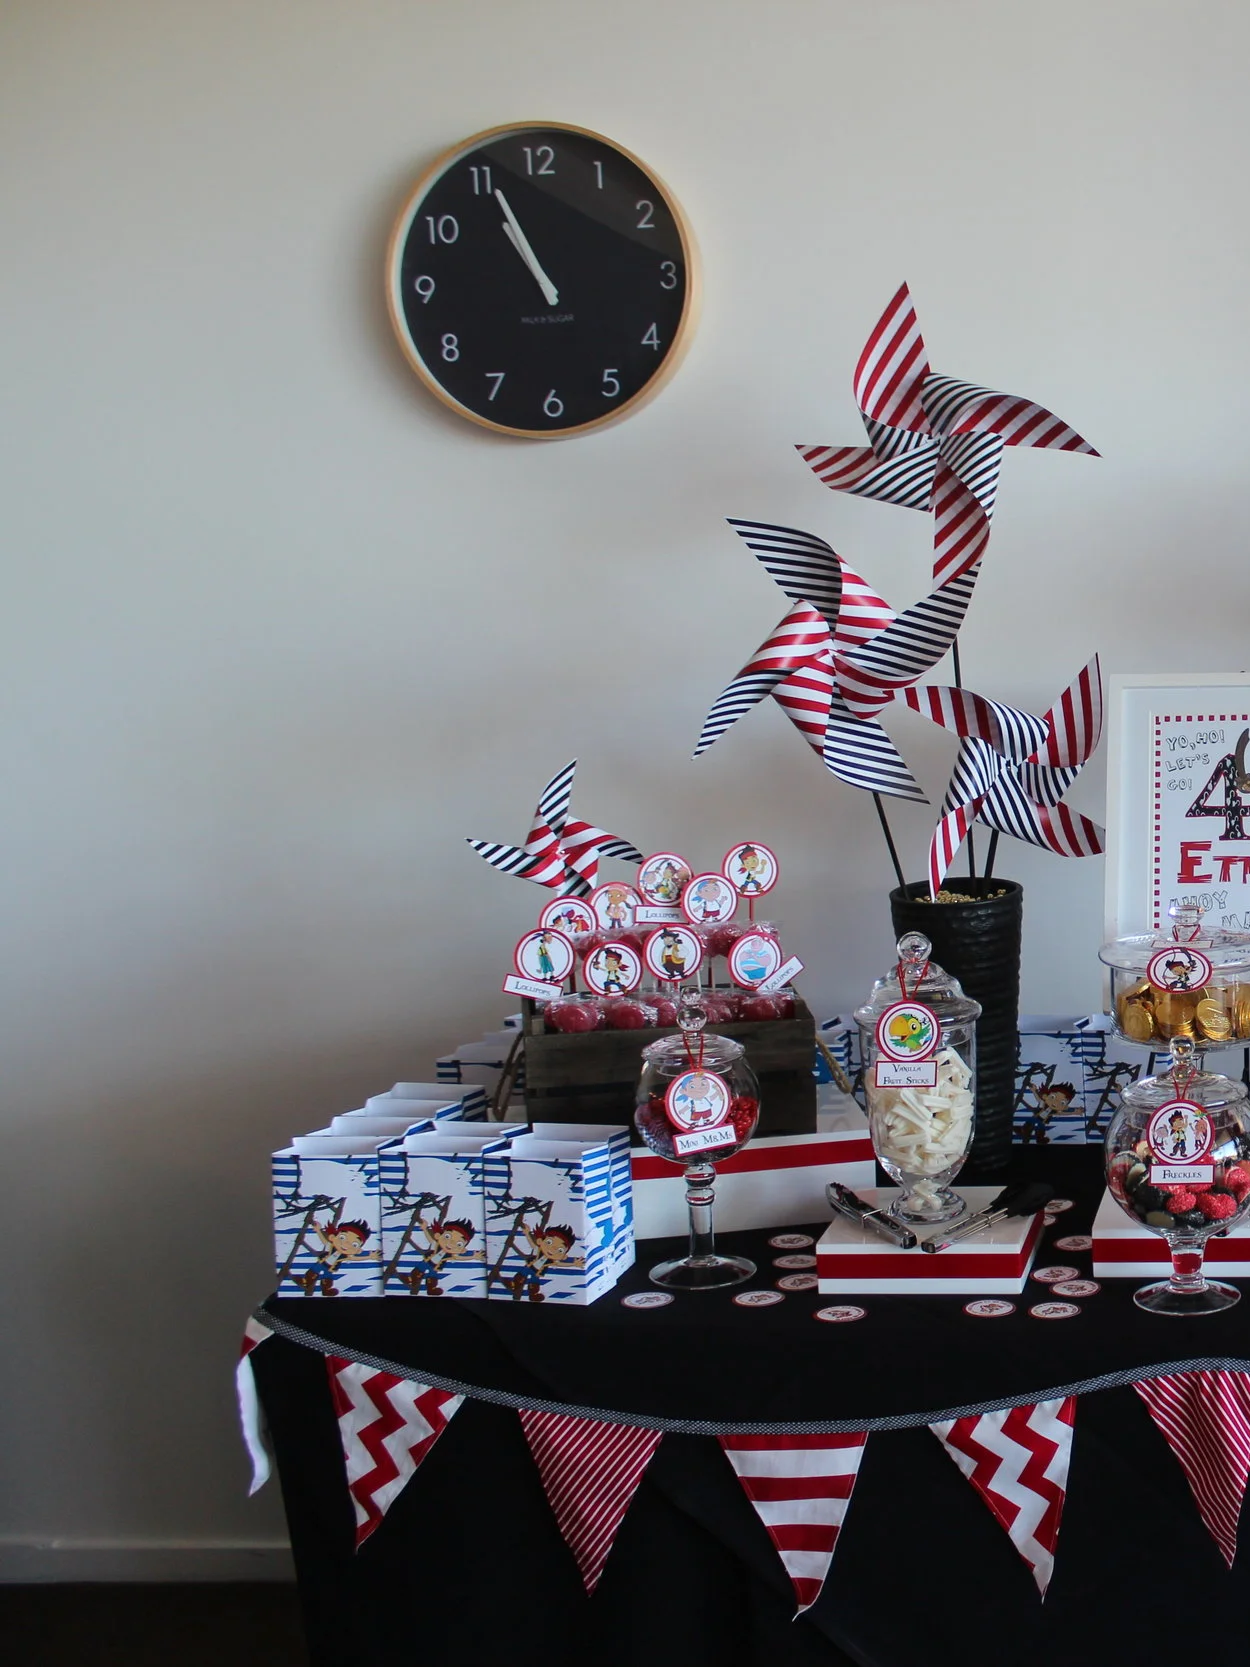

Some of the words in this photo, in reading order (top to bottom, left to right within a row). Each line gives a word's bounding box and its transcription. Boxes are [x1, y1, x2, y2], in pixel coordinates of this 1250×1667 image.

[522, 146, 556, 175] 12
[469, 166, 492, 195] 11
[593, 161, 603, 189] 1
[635, 200, 655, 229] 2
[425, 214, 460, 244] 10
[659, 261, 678, 289] 3
[414, 275, 436, 304] 9
[441, 333, 460, 362] 8
[640, 322, 661, 350] 4
[485, 372, 505, 401] 7
[601, 369, 620, 397] 5
[543, 389, 564, 417] 6
[1165, 753, 1210, 772] LET'S
[1167, 778, 1193, 791] GO!
[1162, 1169, 1202, 1179] FRECKLES
